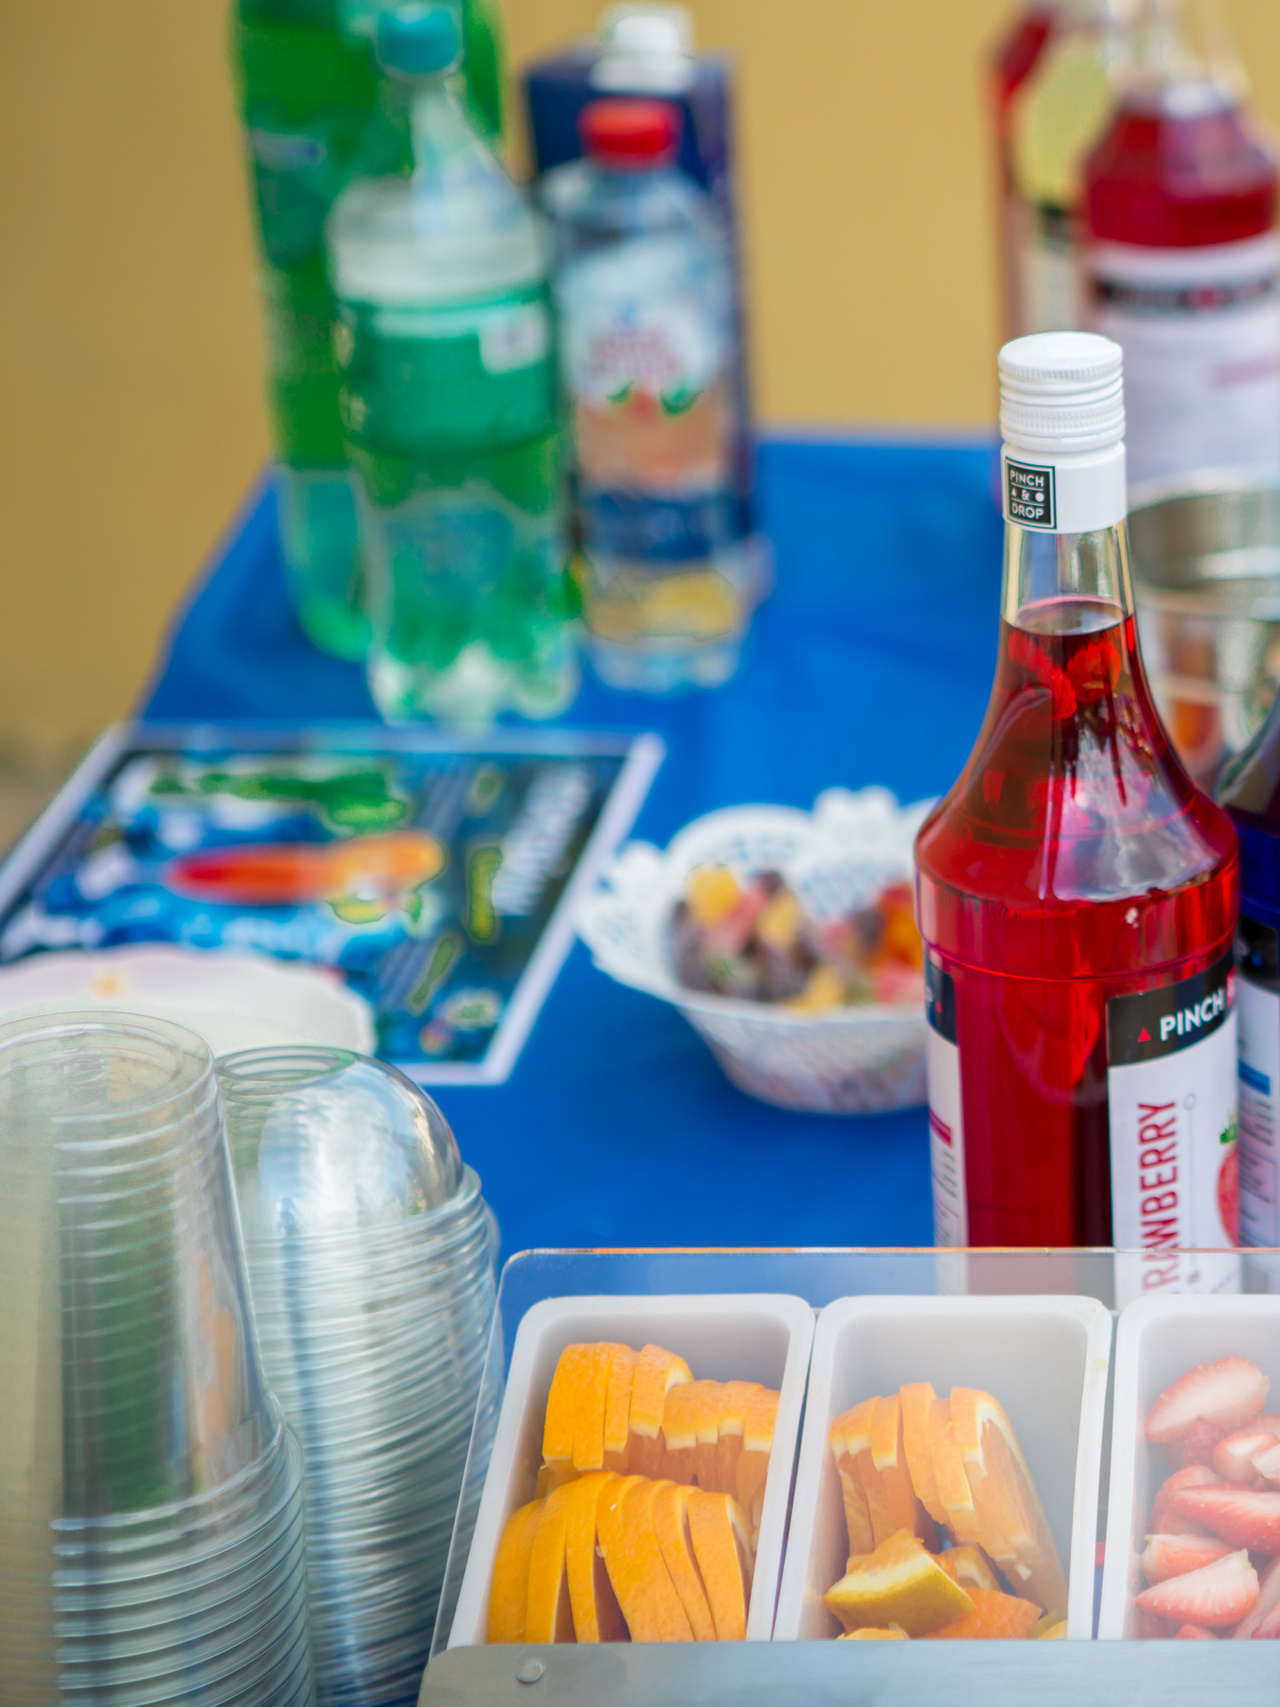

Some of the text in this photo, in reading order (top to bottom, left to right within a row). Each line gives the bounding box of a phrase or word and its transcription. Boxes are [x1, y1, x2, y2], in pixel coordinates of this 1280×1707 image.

[1010, 469, 1045, 488] PINCH
[1021, 489, 1031, 501] &
[1012, 502, 1045, 520] DROP
[1160, 986, 1225, 1041] PINCH
[1137, 1101, 1179, 1293] RAWBERRY
